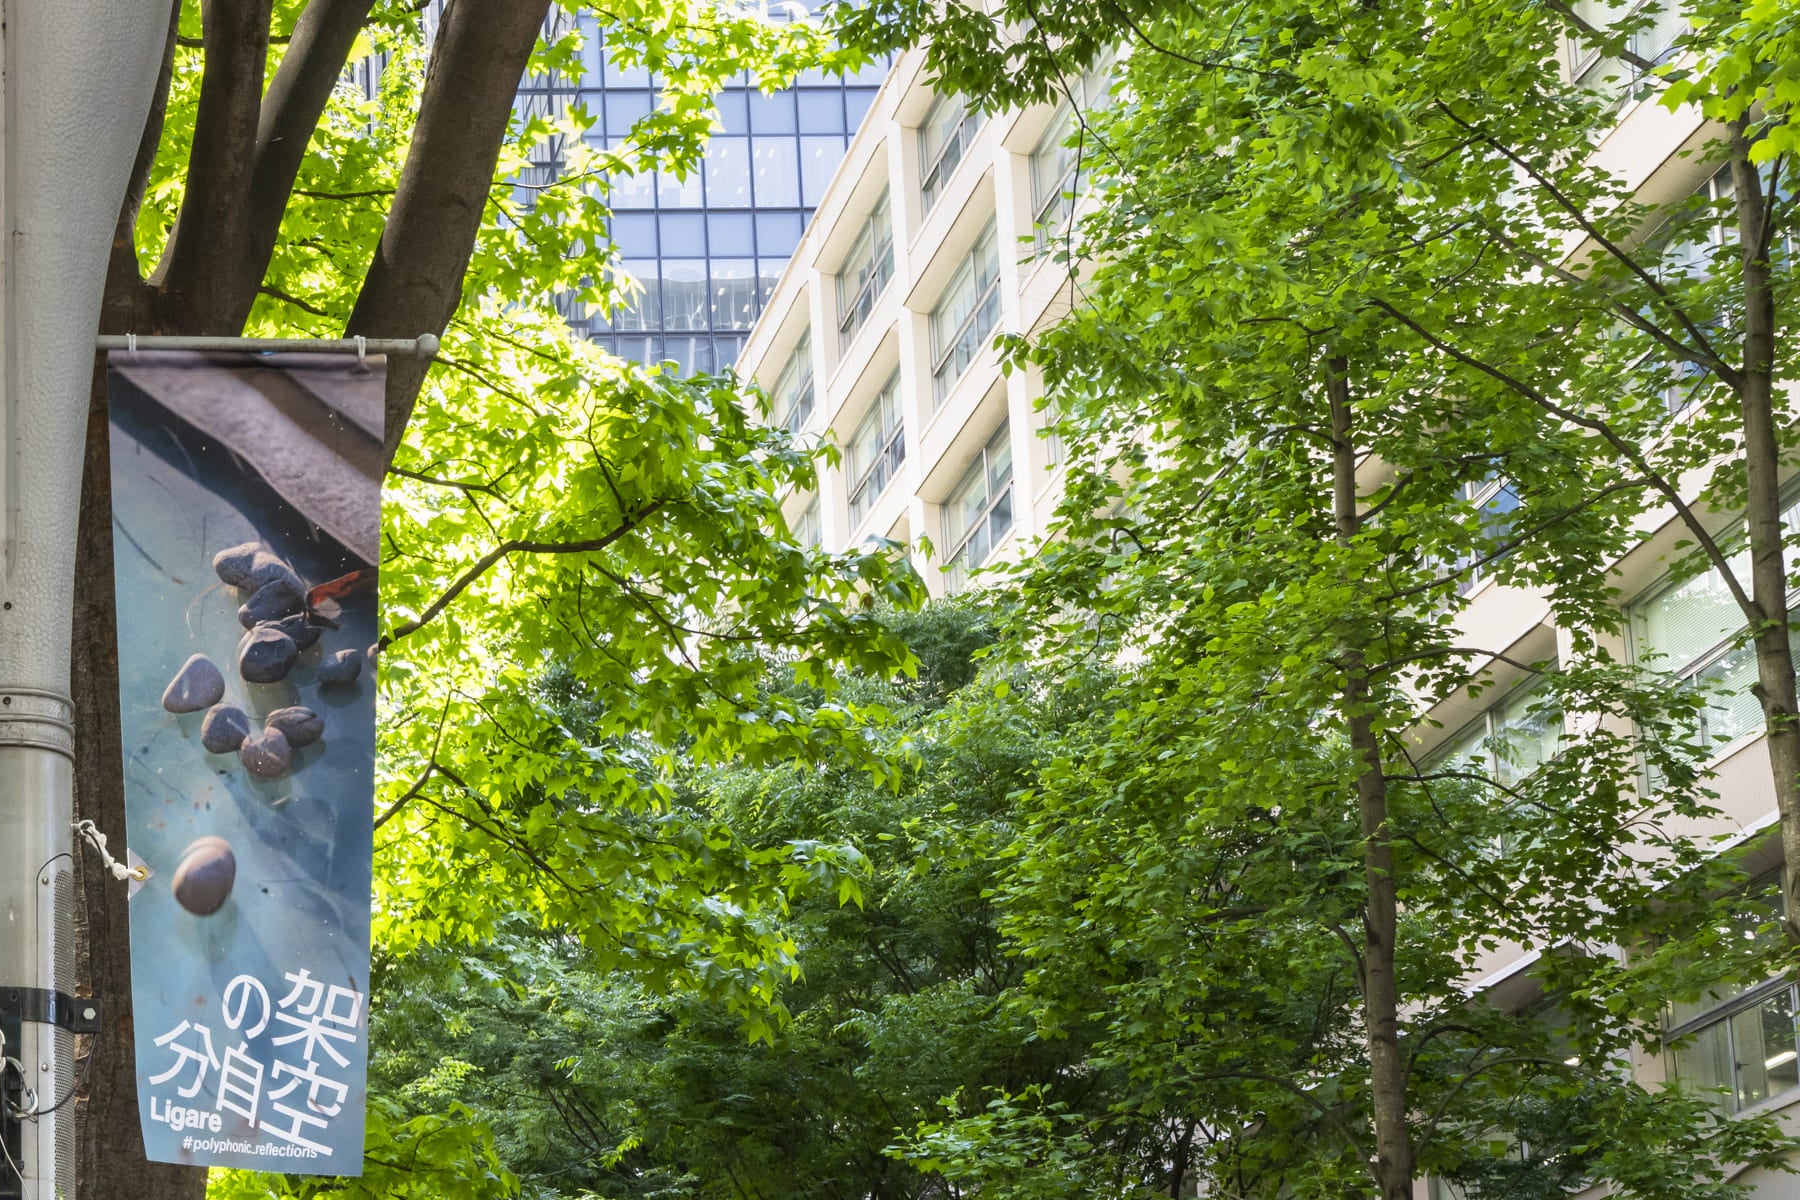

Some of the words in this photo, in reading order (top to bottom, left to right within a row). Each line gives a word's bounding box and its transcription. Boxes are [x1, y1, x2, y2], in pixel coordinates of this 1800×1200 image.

[259, 968, 364, 1156] 架空
[150, 1096, 222, 1133] Ligare
[183, 1135, 318, 1159] #polyphonic_reflections
